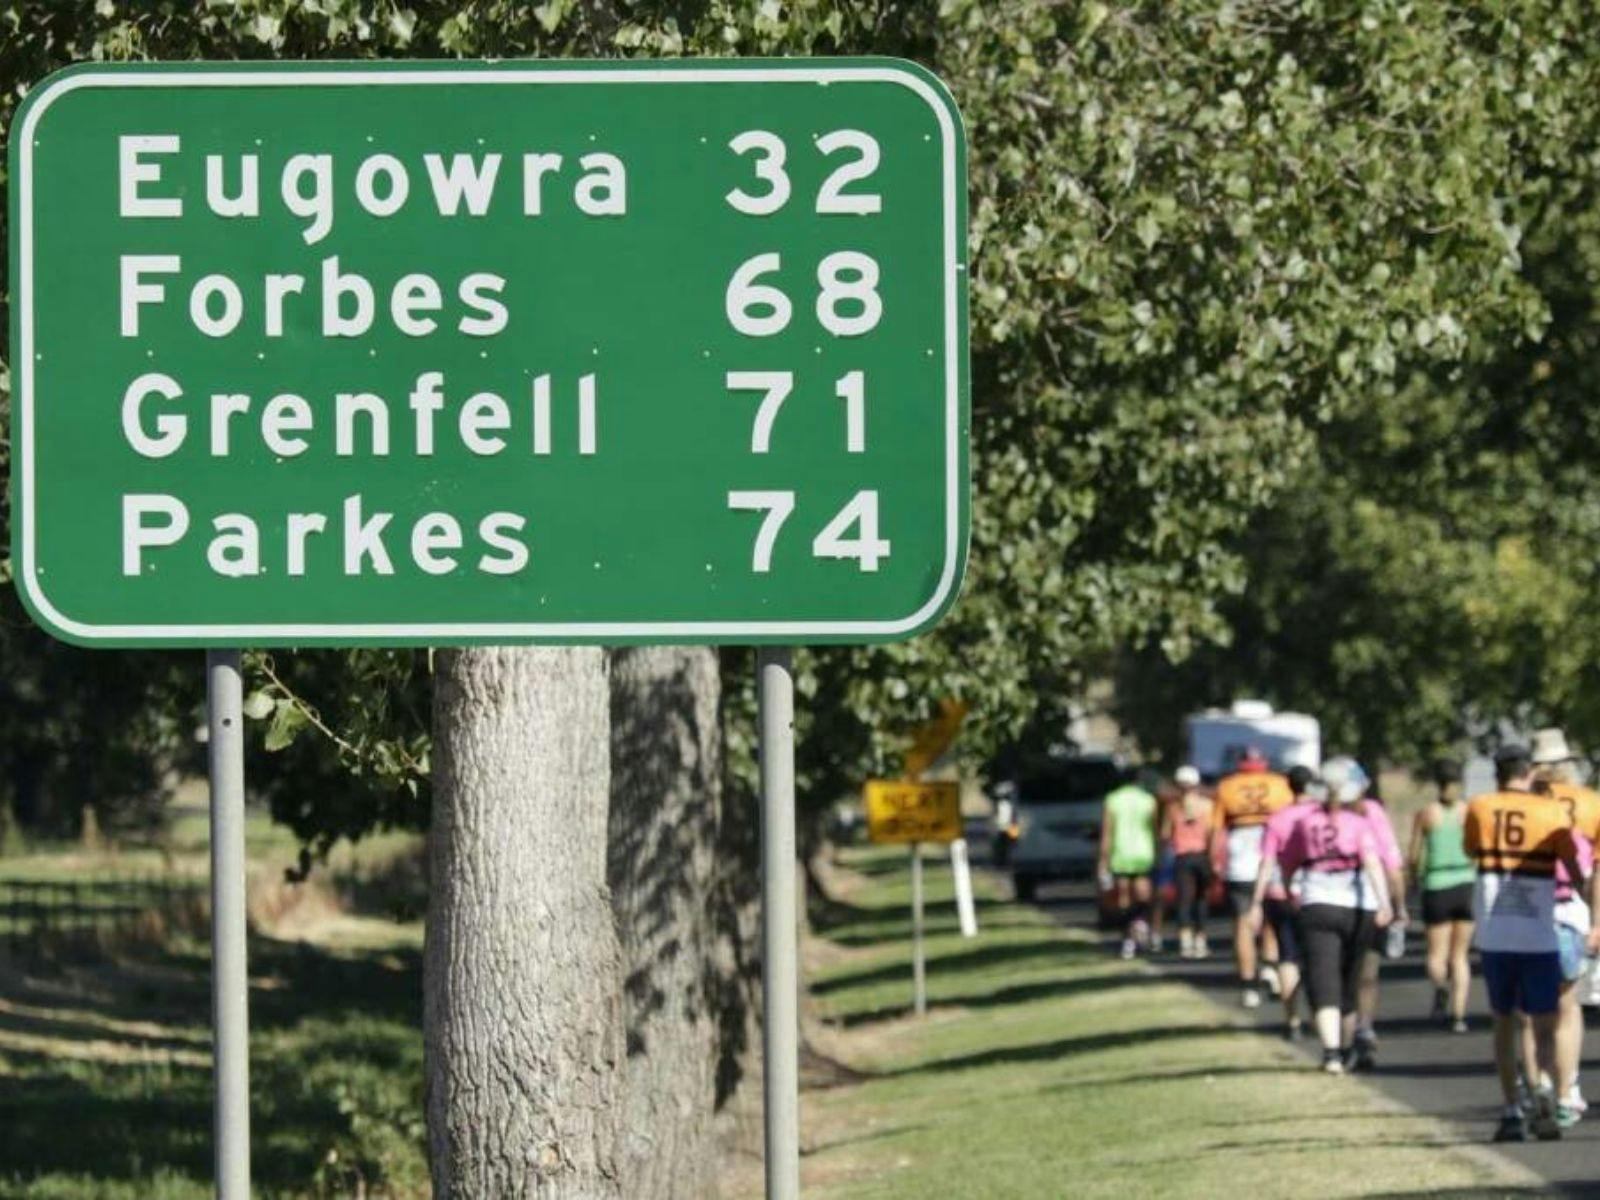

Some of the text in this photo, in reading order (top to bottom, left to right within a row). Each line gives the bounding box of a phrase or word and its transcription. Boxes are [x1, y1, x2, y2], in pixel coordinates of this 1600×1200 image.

[119, 129, 882, 244] Eugowra 32
[120, 251, 883, 337] Forbes 68
[122, 371, 866, 457] Grenfell 71
[122, 490, 890, 577] Parkes 74
[1310, 824, 1338, 855] 12
[1493, 809, 1526, 848] 16
